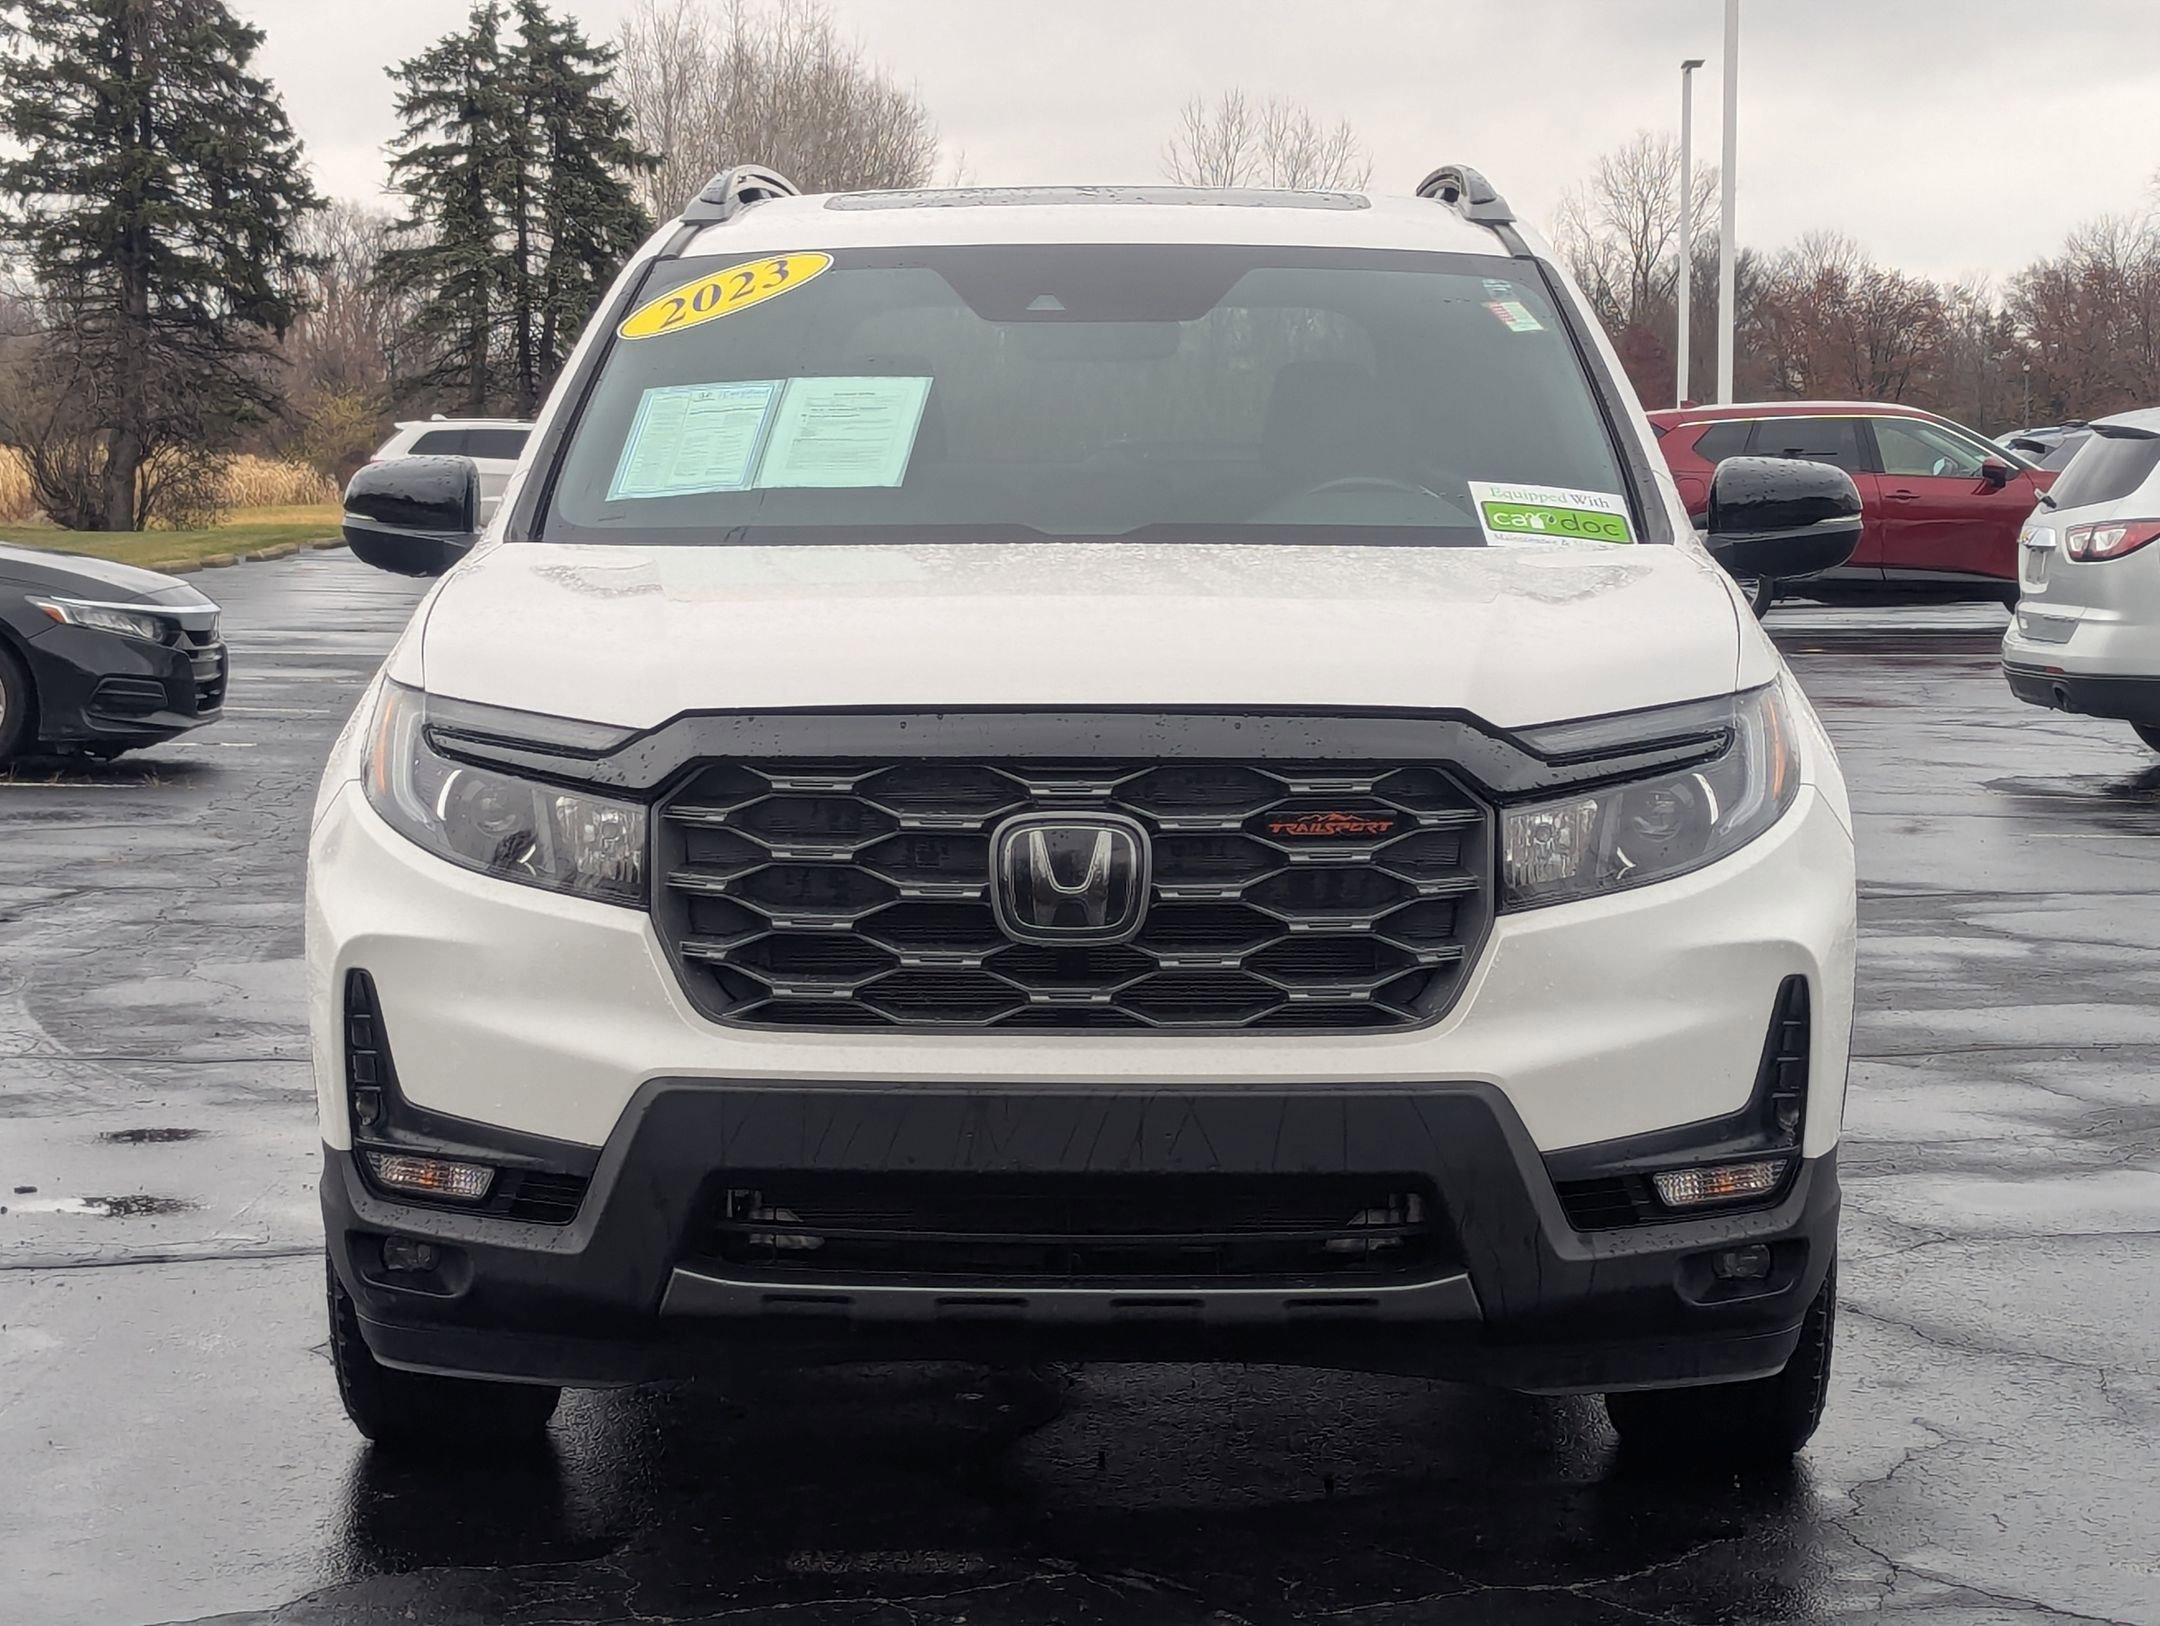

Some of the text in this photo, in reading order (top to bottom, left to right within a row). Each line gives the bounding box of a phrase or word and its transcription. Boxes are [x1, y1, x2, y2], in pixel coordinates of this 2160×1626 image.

[659, 259, 790, 330] 2023
[1490, 487, 1611, 509] Equipped With
[1269, 821, 1394, 836] TRAILSPORT
